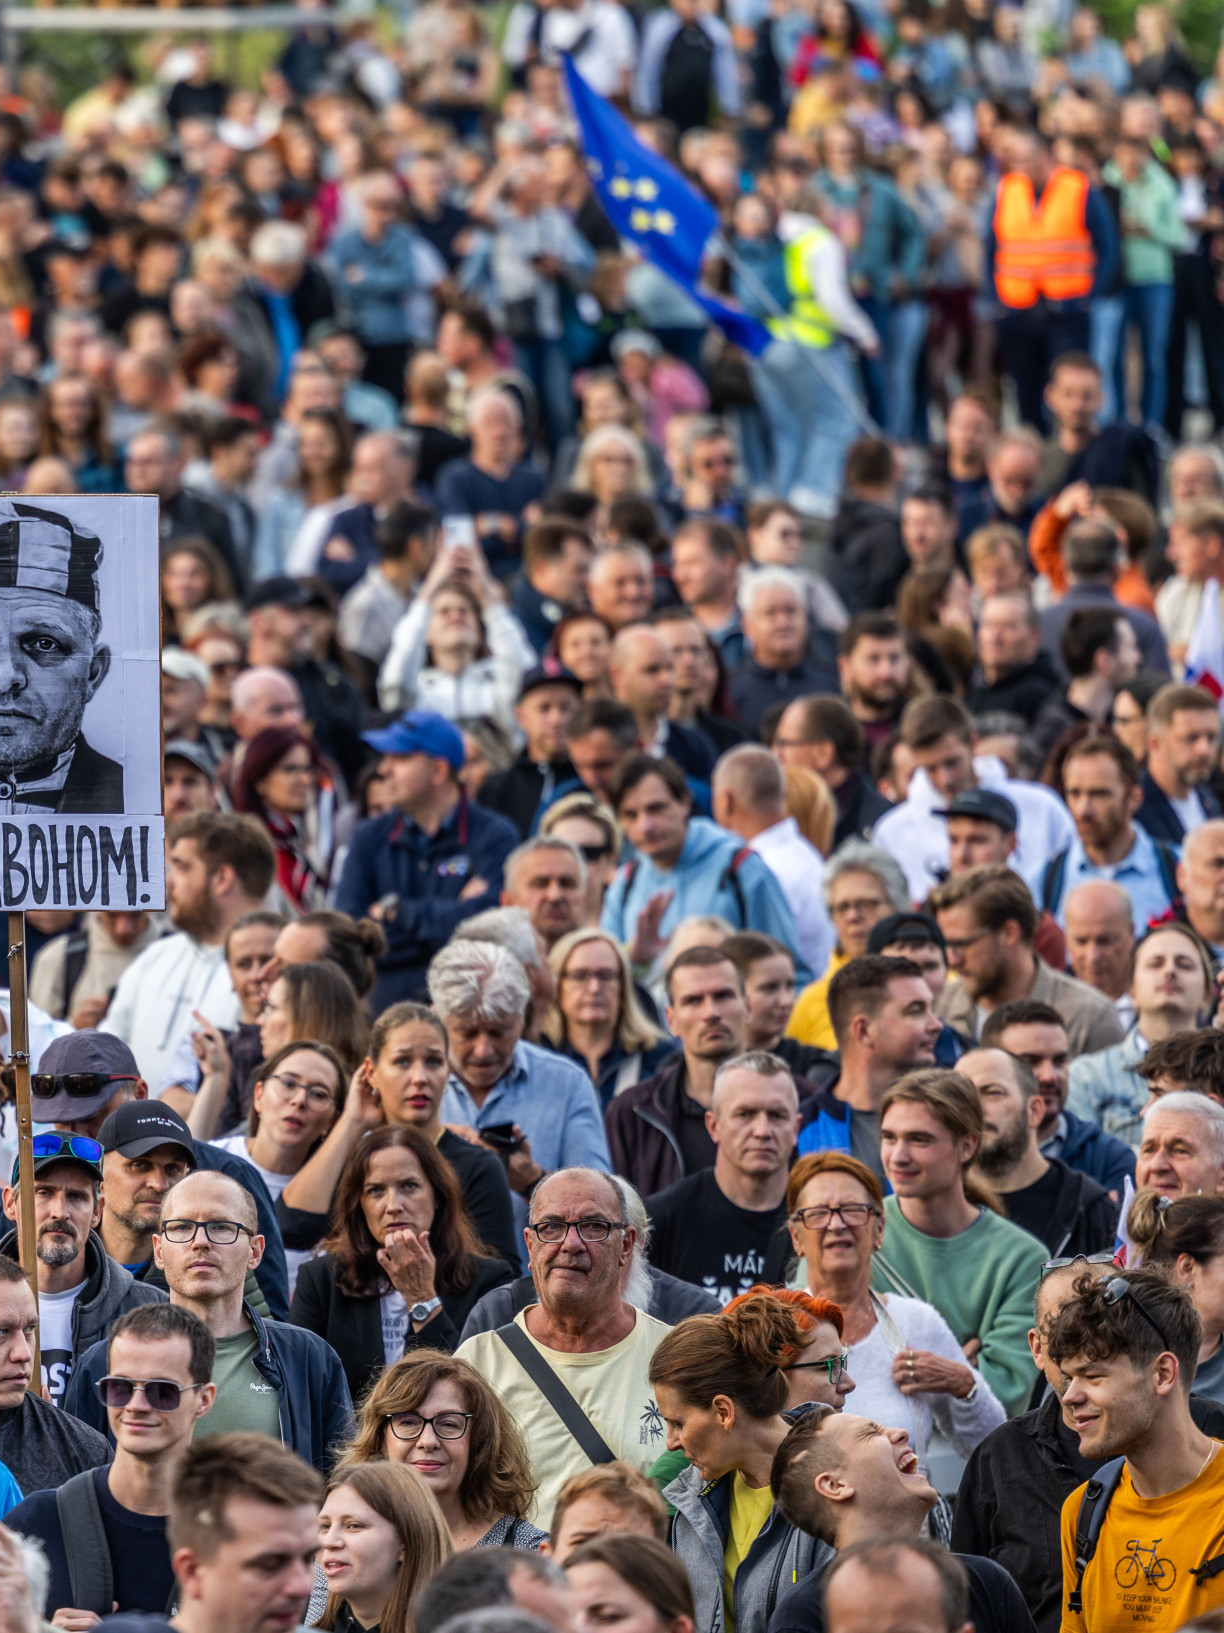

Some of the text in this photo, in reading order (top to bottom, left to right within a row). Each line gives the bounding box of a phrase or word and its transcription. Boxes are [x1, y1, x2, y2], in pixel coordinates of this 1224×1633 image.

[1123, 1593, 1136, 1601] KEEP
[1138, 1595, 1152, 1603] YOUR
[1123, 1603, 1134, 1611] YOU
[1136, 1604, 1151, 1612] MUST
